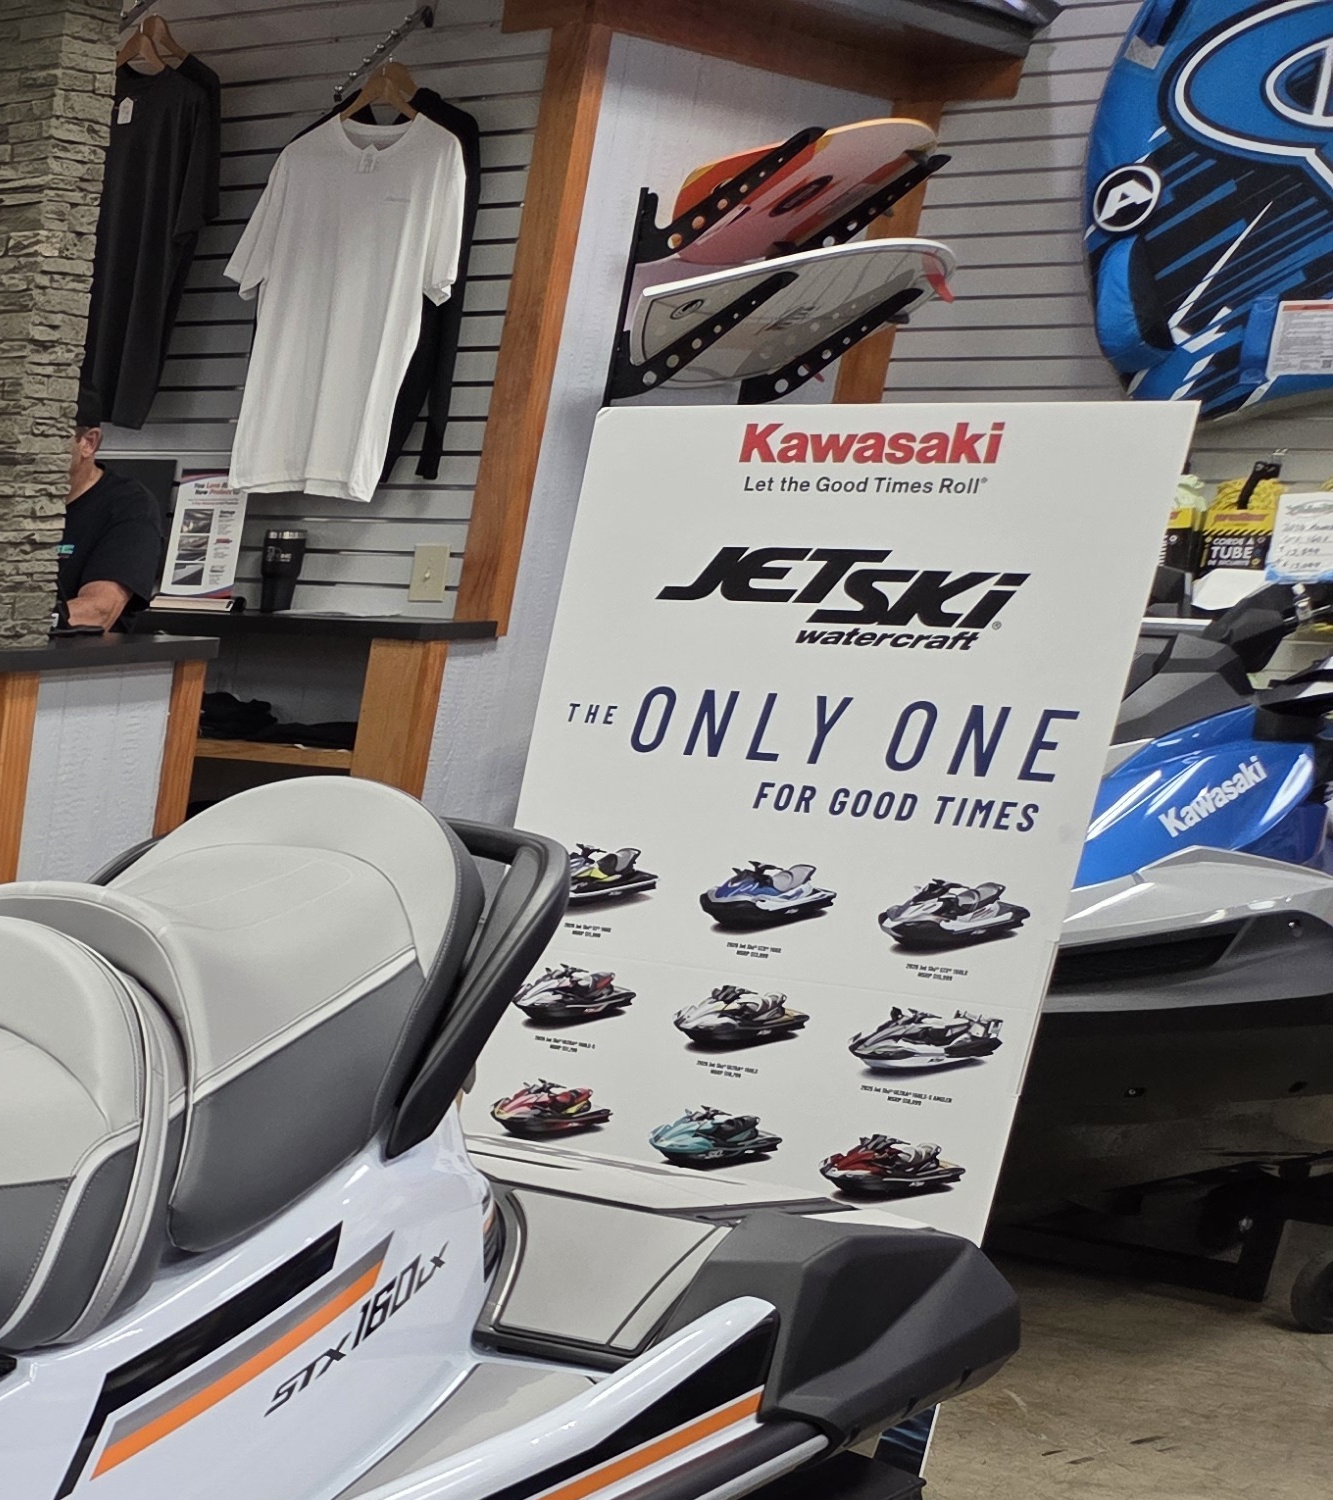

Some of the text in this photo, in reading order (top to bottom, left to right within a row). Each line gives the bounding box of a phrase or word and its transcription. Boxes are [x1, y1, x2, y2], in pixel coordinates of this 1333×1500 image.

[738, 422, 1005, 464] Kawasaki
[743, 476, 774, 492] Let
[778, 476, 810, 492] the
[816, 476, 869, 493] Good
[874, 477, 933, 494] Times
[1210, 546, 1254, 559] TUBE
[795, 628, 981, 651] watercraft
[567, 686, 1081, 783] THE ONLY ONE
[753, 782, 1040, 832] FOR GOOD TIMES
[1157, 755, 1267, 838] Kawasaki
